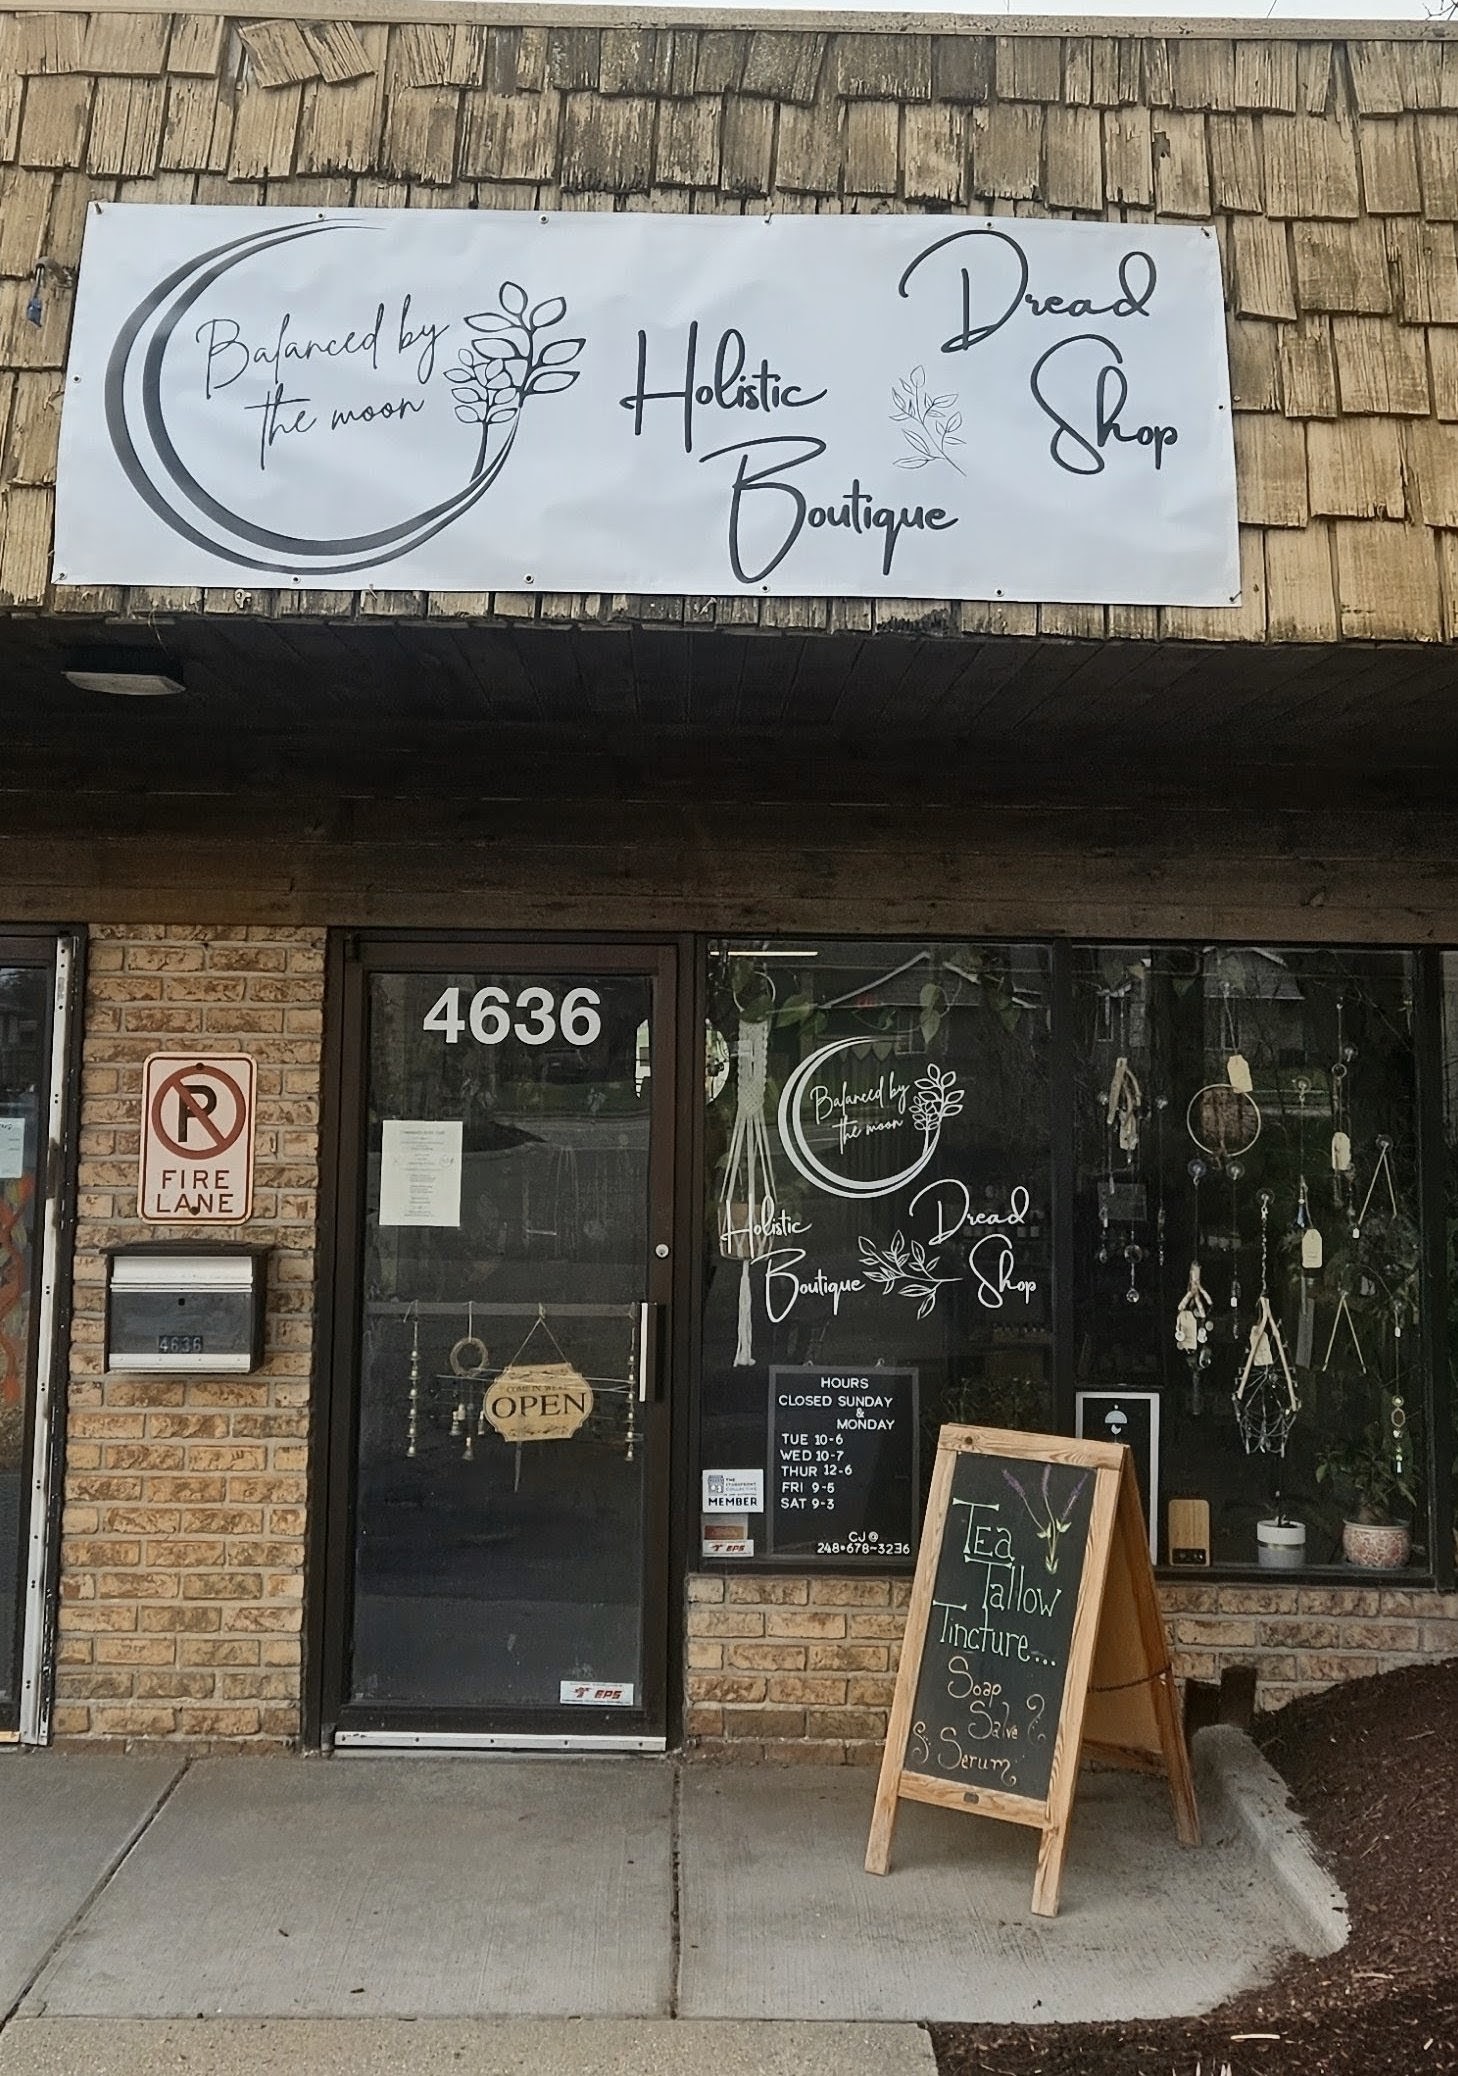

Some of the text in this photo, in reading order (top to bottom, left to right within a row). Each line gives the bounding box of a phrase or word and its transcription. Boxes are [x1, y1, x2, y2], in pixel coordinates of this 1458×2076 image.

[898, 229, 1157, 353] Dread
[196, 294, 450, 399] Balanced by
[619, 321, 827, 453] Holistic
[1030, 334, 1178, 475] Shop
[244, 383, 425, 470] the moon
[699, 436, 959, 584] Boutique
[423, 987, 601, 1045] 4636
[810, 1071, 910, 1124] Balanced by
[832, 1118, 904, 1154] the moon
[162, 1170, 229, 1189] FIRE
[156, 1194, 234, 1214] LANE
[909, 1179, 1029, 1245] Dread
[720, 1193, 812, 1258] Holistic
[750, 1249, 866, 1323] Boutique
[969, 1234, 1036, 1309] Shop
[160, 1336, 201, 1352] 4636
[778, 1395, 893, 1408] CLOSED SUNDAY
[820, 1377, 869, 1390] HOURS
[491, 1392, 586, 1418] OPEN
[836, 1418, 895, 1430] MONDAY
[856, 1408, 865, 1418] &
[780, 1450, 844, 1462] WED 10-7
[782, 1433, 844, 1446] TUE 10-6
[781, 1464, 853, 1477] THUR 12-6
[782, 1481, 835, 1494] FRI 9-5
[708, 1497, 758, 1507] MEMBER
[780, 1498, 835, 1510] SAT 9-3
[848, 1531, 879, 1543] CJ @
[964, 1555, 1062, 1617] Tallow
[933, 1600, 1056, 1667] Tincture...
[595, 1689, 622, 1699] EPS
[948, 1655, 1002, 1707] Soap
[967, 1700, 1018, 1741] Salve
[937, 1727, 1017, 1787] Serum
